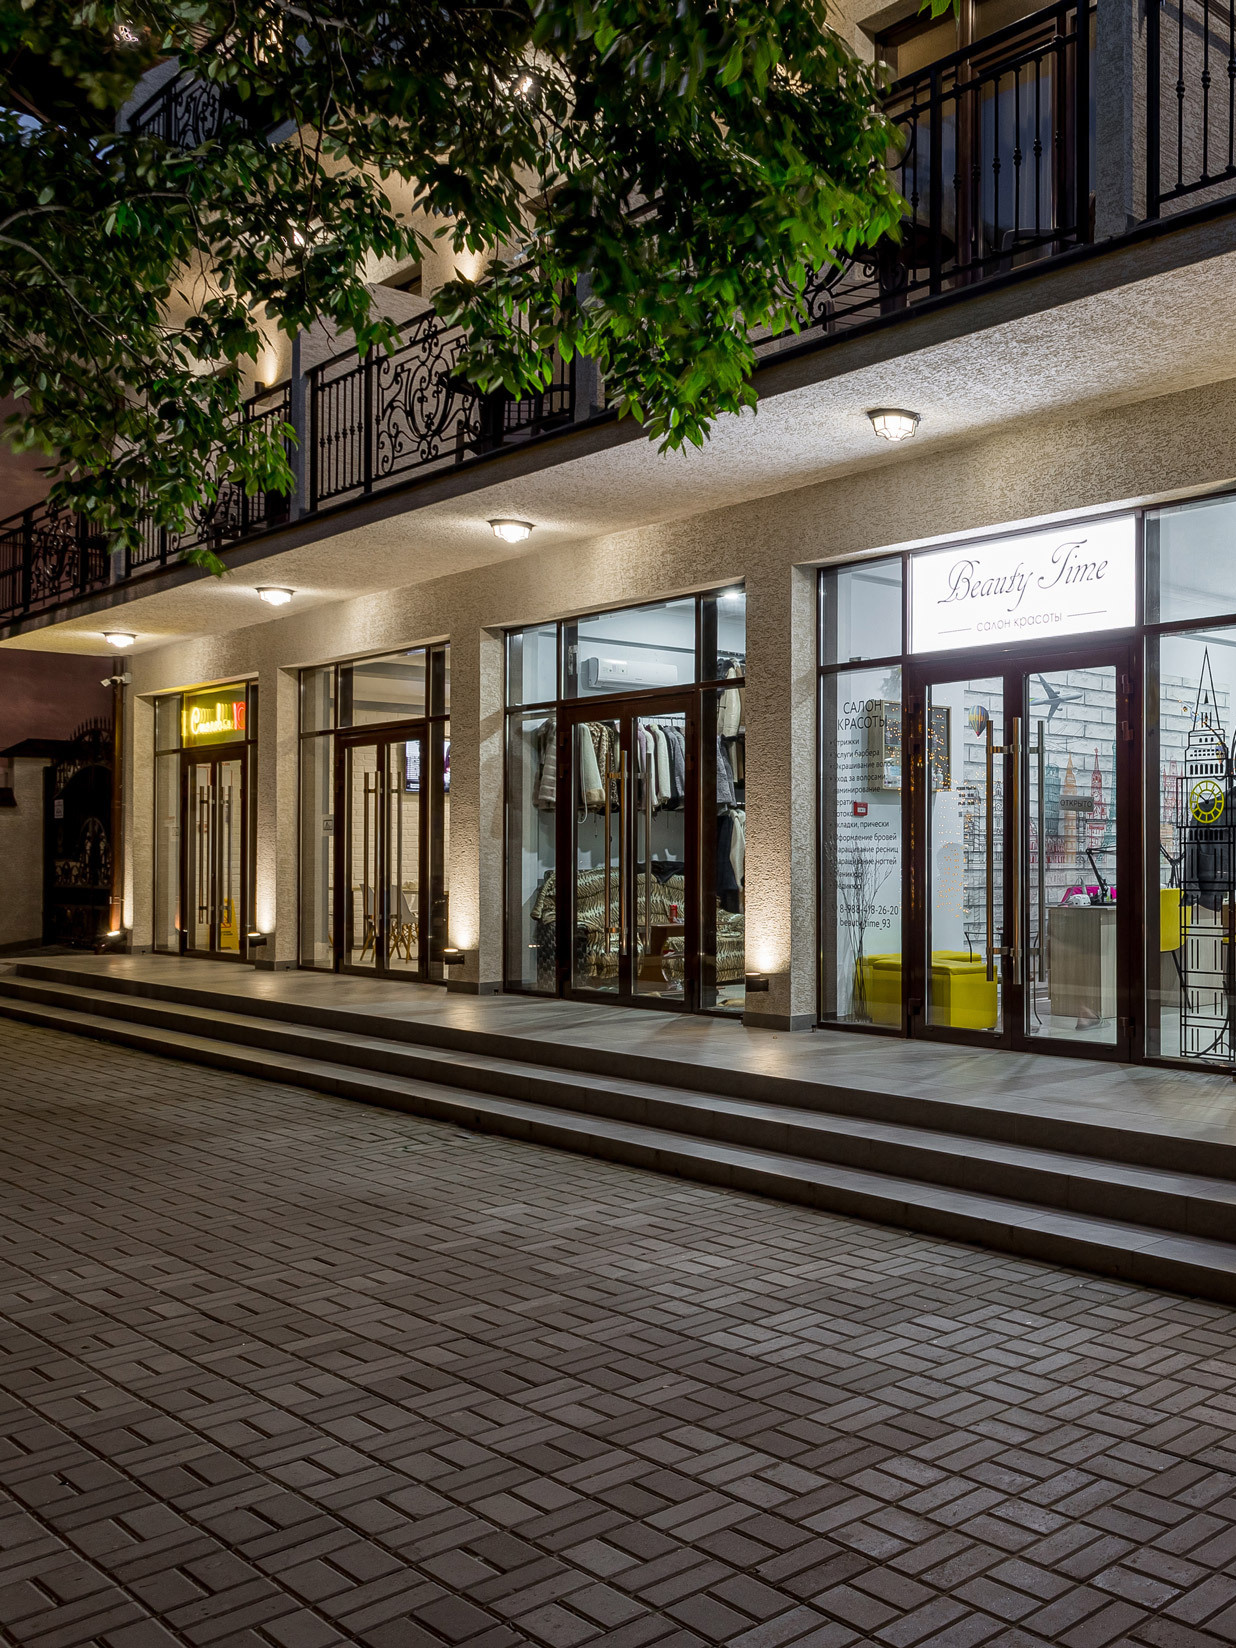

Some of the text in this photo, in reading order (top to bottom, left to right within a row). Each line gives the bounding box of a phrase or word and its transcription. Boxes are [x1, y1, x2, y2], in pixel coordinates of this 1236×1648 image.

[937, 539, 1109, 612] Beauty Time
[976, 611, 1063, 632] салон красоты
[843, 698, 882, 715] САЛОН
[1059, 798, 1094, 808] ОТКРЫТО
[860, 820, 890, 830] прически
[873, 832, 897, 841] бровей
[832, 846, 899, 855] аращивание ресниц
